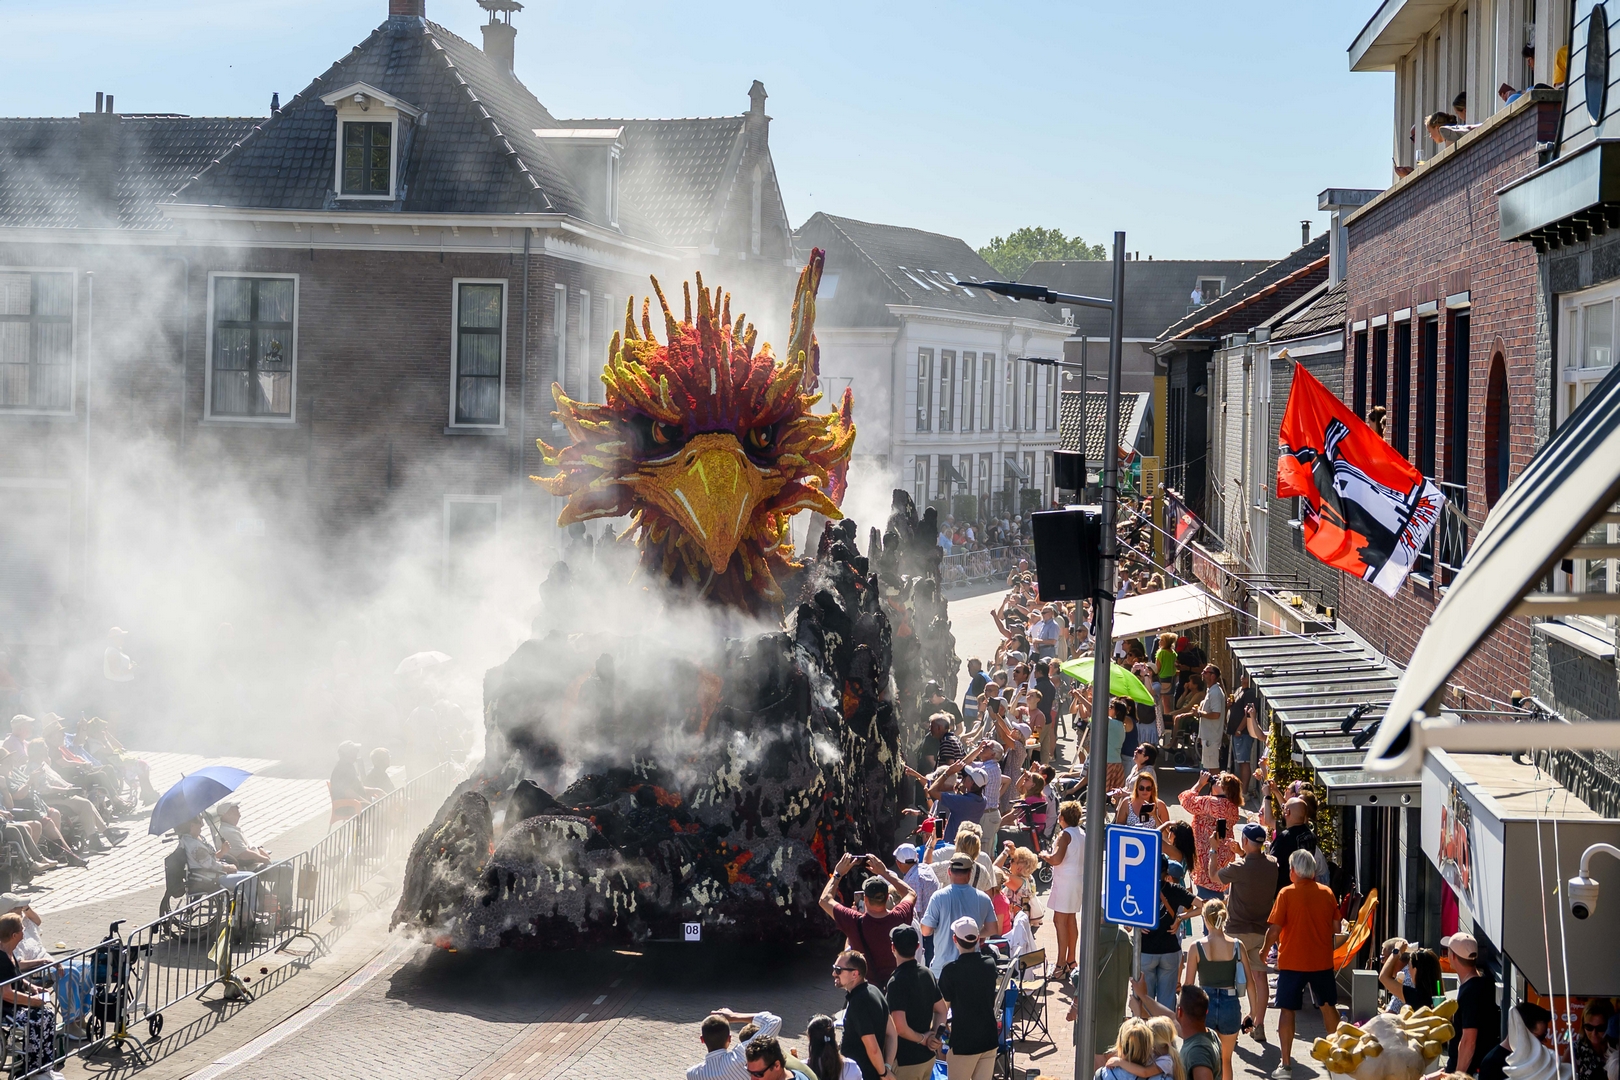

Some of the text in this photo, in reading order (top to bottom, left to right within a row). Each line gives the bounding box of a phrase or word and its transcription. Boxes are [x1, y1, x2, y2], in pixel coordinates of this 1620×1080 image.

[818, 376, 854, 404] TZ
[1118, 835, 1146, 882] P
[685, 925, 699, 935] 08
